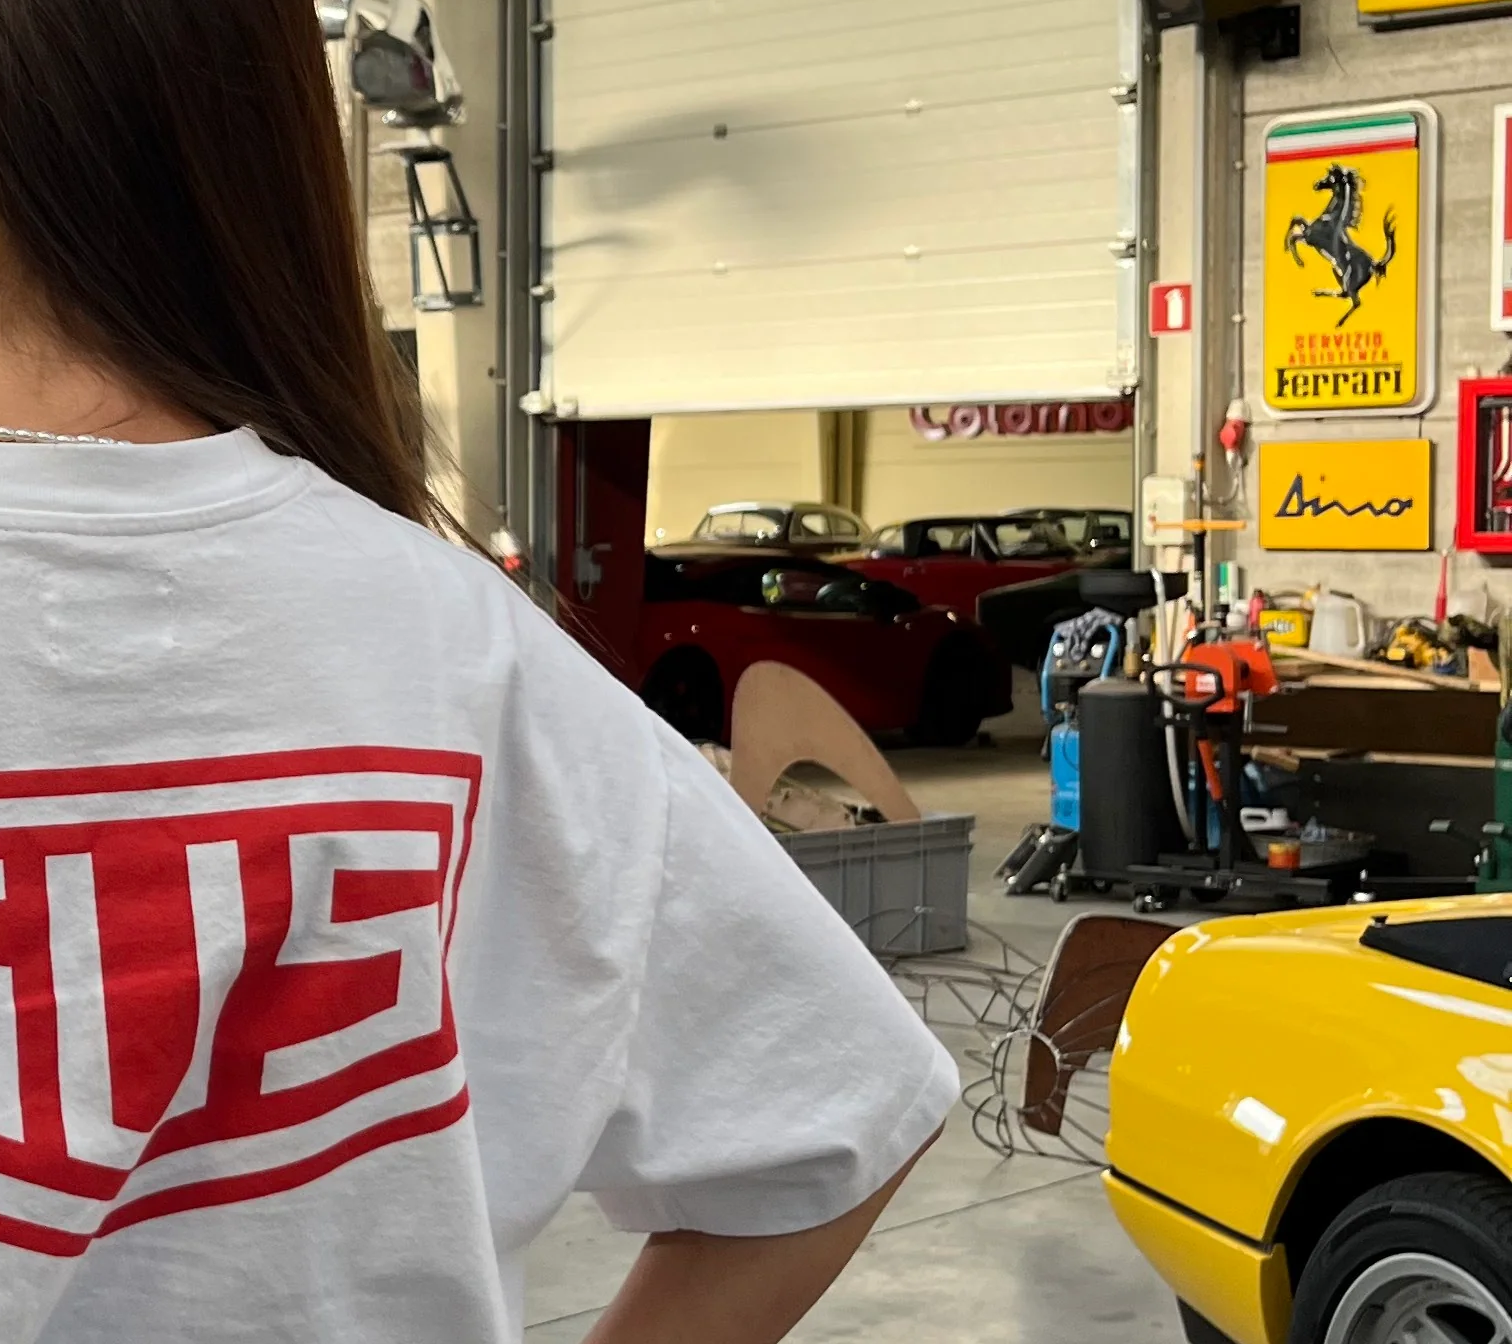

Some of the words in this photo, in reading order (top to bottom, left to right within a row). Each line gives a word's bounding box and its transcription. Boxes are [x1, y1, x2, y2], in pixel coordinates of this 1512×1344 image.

[1294, 331, 1383, 350] SERVIZIO
[1274, 364, 1402, 398] Ferrari
[1274, 471, 1413, 517] Dino
